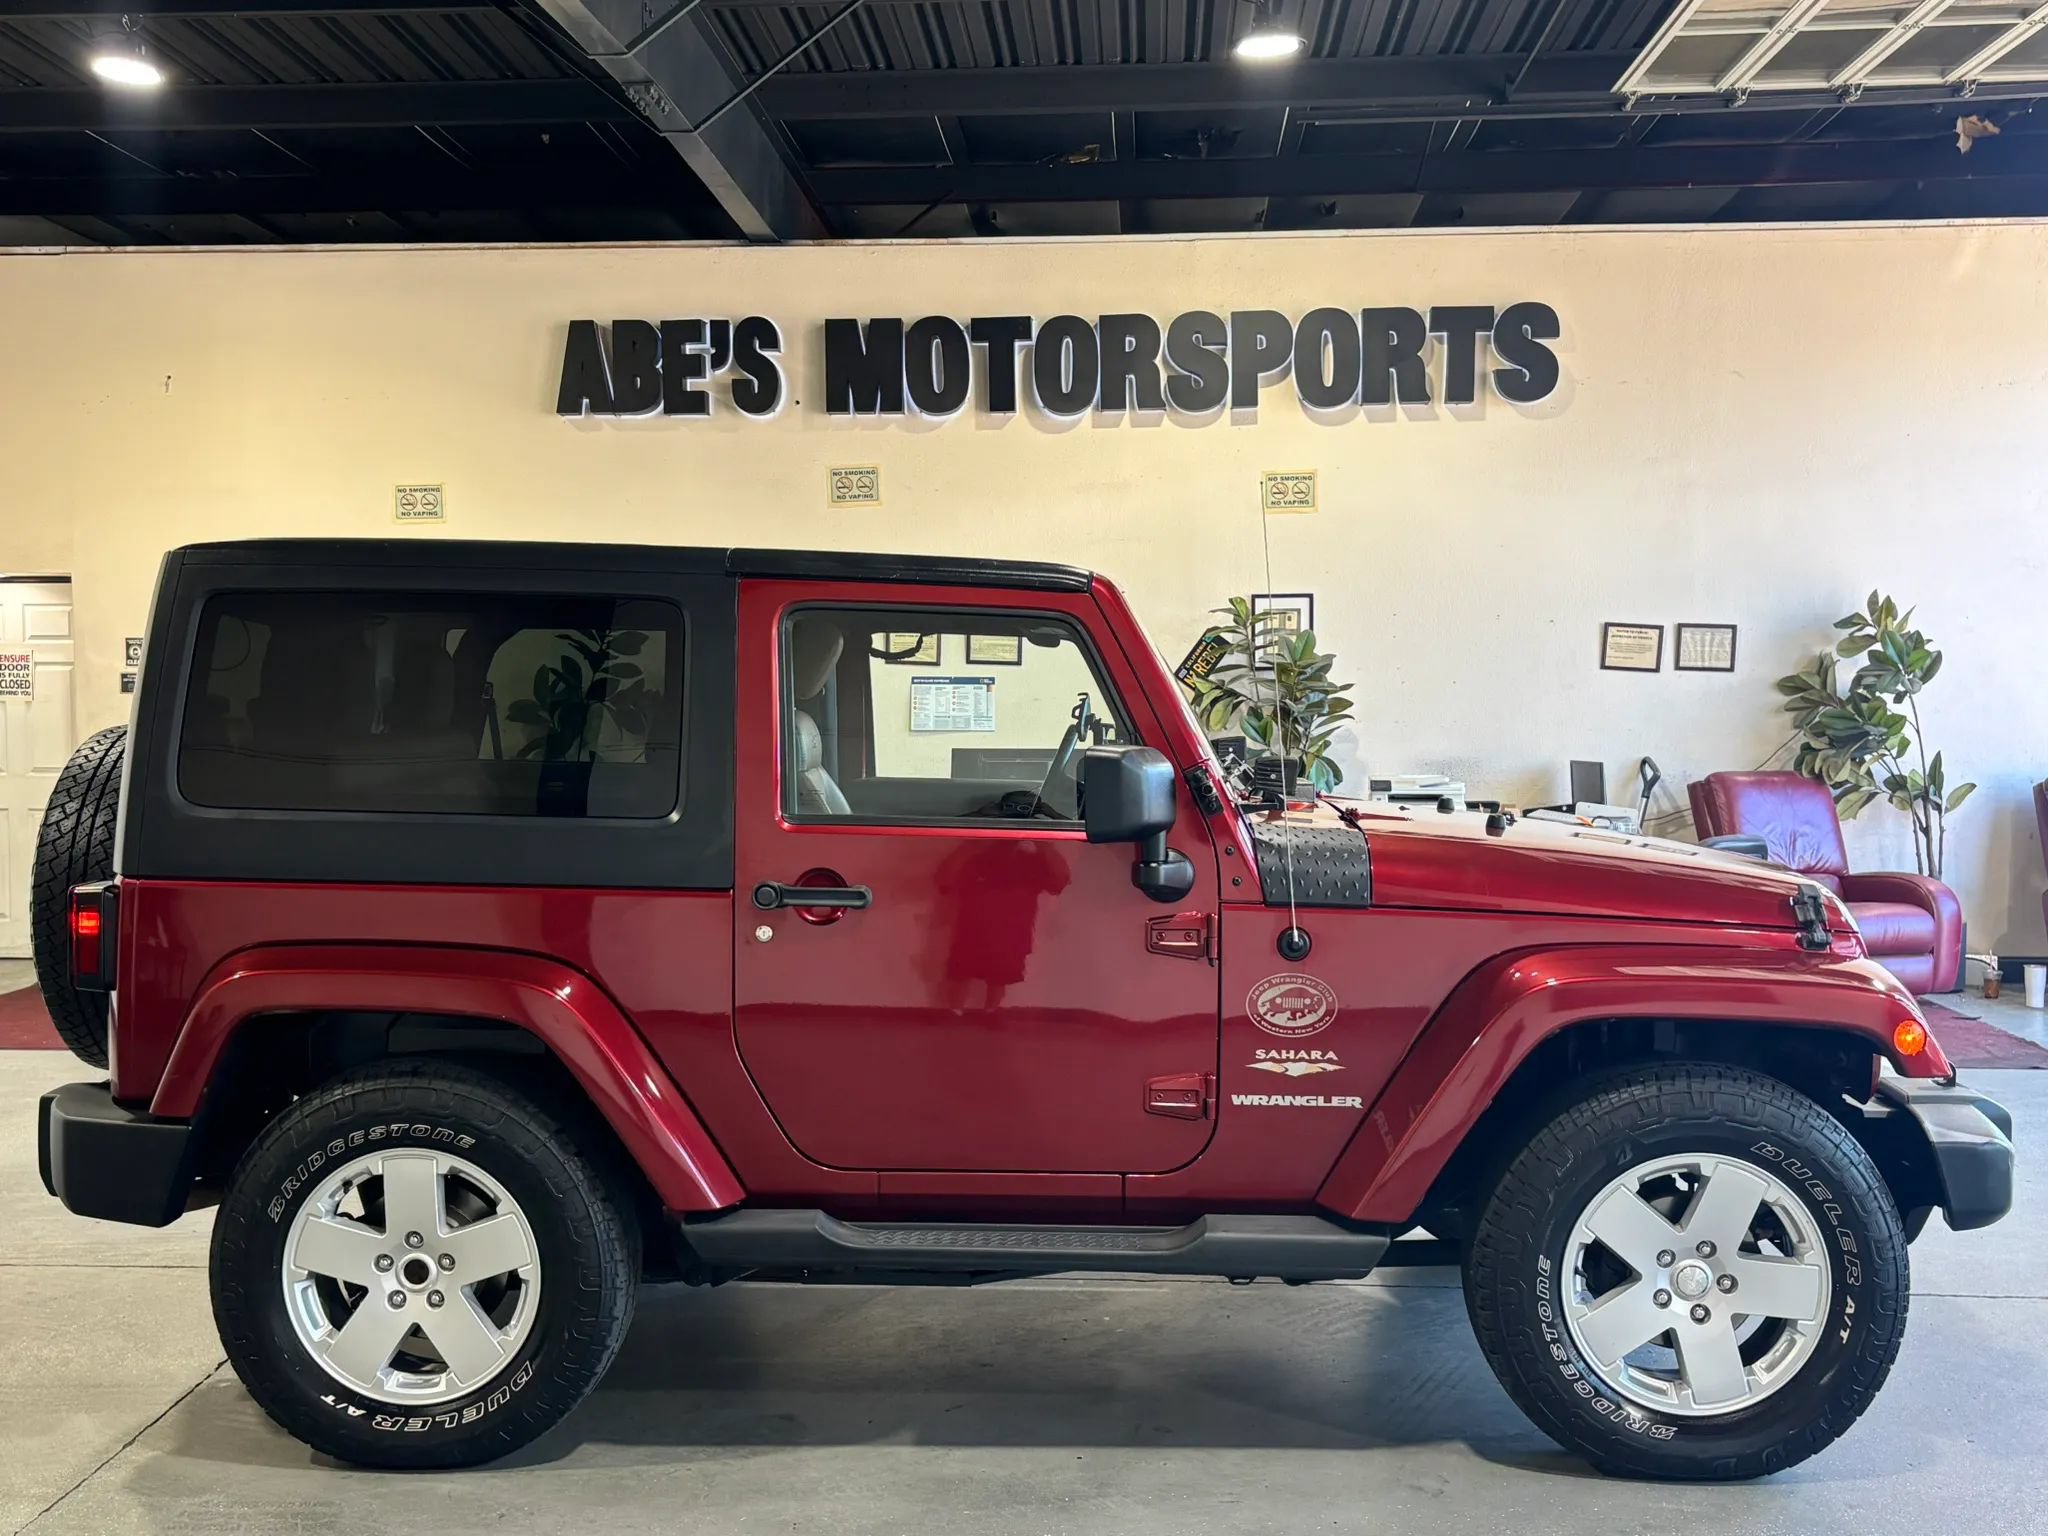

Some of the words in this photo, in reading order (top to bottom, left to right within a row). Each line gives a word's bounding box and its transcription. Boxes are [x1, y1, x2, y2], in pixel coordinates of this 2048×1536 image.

[556, 315, 783, 416] ABE'S
[824, 302, 1560, 416] MOTORSPORTS
[0, 654, 31, 663] ENSURE
[0, 679, 31, 689] CLOSED
[1251, 982, 1270, 1000] Jeep
[1271, 977, 1317, 986] Wrangler
[1318, 984, 1334, 1002] Club
[1261, 1020, 1293, 1034] Western
[1314, 1016, 1331, 1028] York
[1255, 1049, 1339, 1061] SAHARA
[1231, 1094, 1364, 1109] WRANGLER
[268, 1123, 476, 1224] BRIDGESTONE
[1751, 1141, 1862, 1287] DUELER
[1839, 1294, 1856, 1344] A/T
[1536, 1254, 1678, 1441] BRIDGESTONE
[320, 1394, 368, 1416] A/T
[372, 1361, 535, 1432] DUELER
